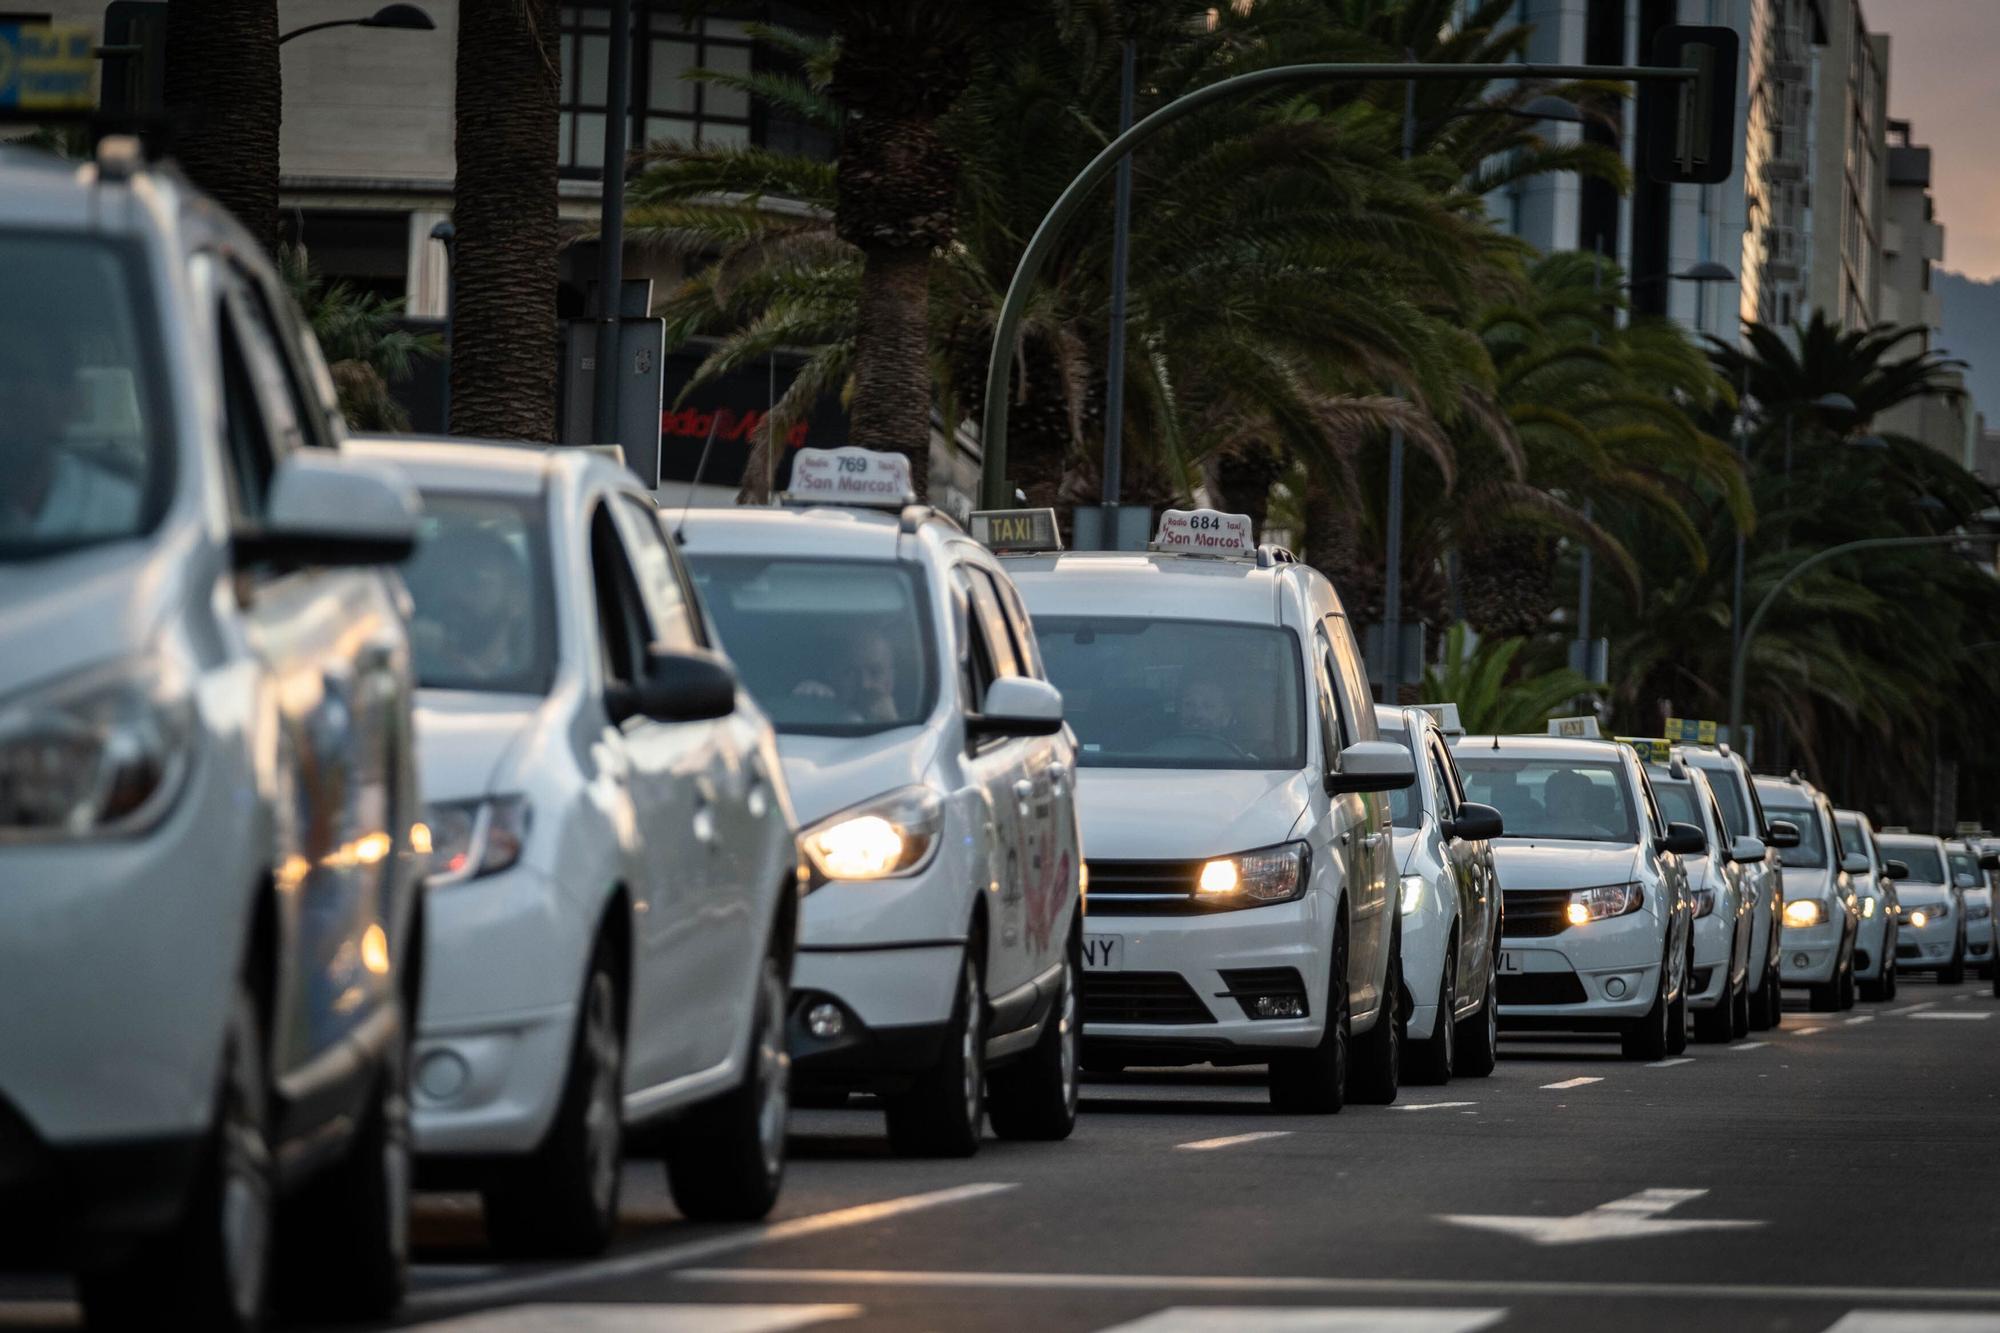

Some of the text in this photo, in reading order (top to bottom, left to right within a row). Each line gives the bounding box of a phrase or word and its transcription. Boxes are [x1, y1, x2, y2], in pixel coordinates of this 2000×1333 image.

[836, 456, 868, 473] 769
[804, 473, 894, 493] San Marcos
[991, 518, 1031, 541] TAXI
[1167, 515, 1241, 530] Radio 684 Taxi
[1167, 531, 1240, 548] San Marcos
